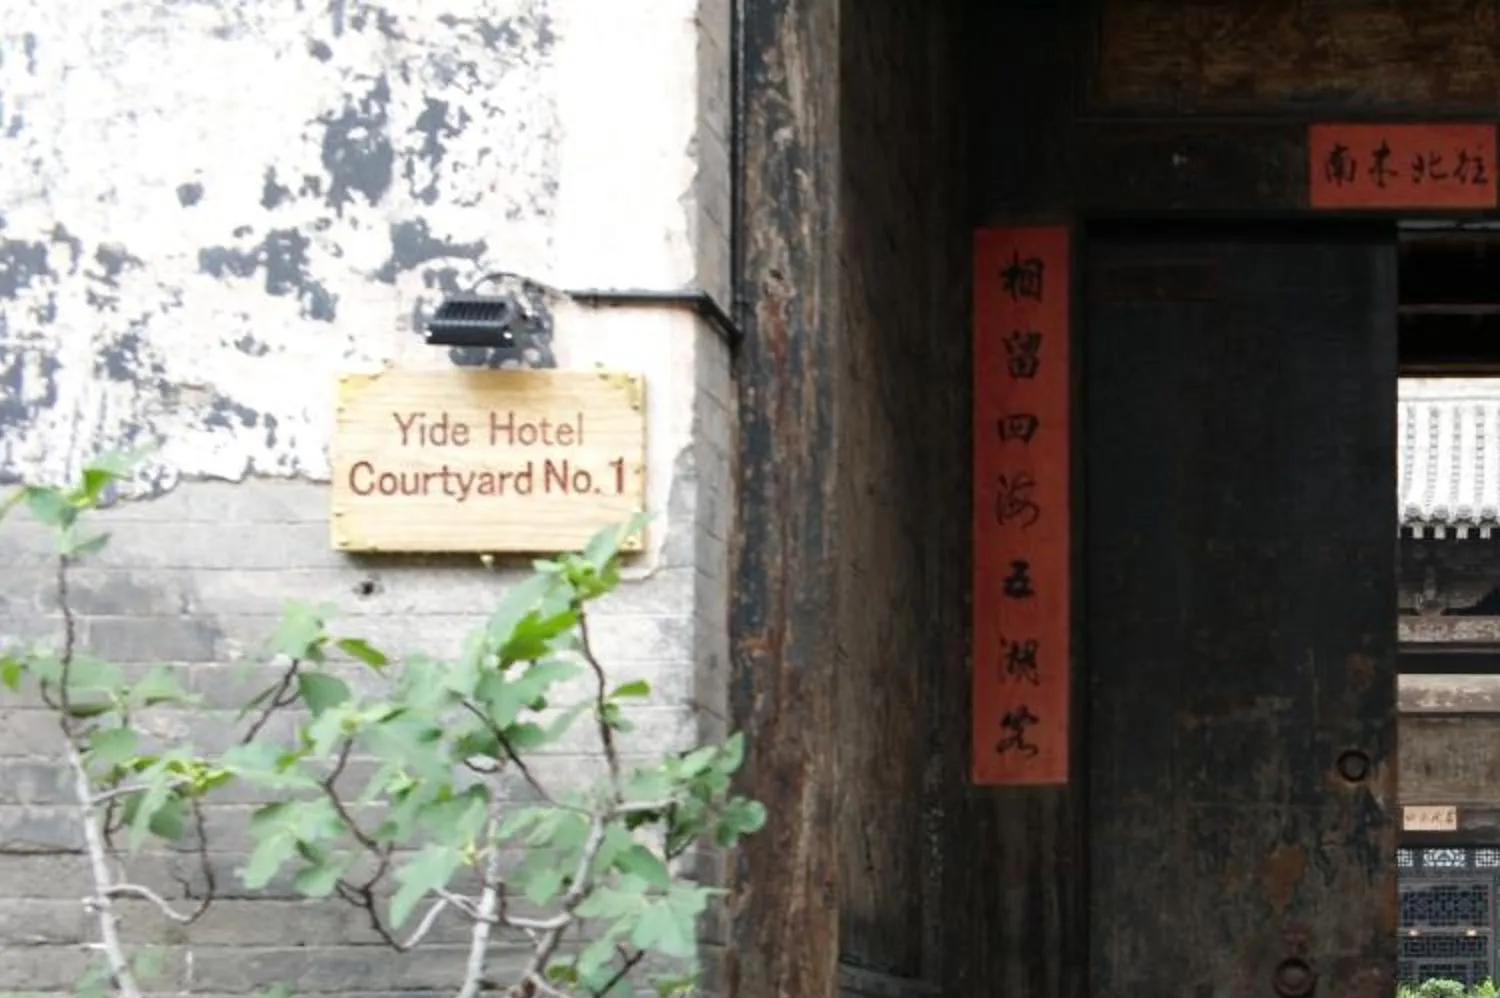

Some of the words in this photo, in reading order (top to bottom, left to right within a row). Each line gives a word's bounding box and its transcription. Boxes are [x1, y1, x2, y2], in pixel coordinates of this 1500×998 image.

[393, 411, 470, 447] Yide
[489, 410, 584, 447] Hotel
[350, 460, 533, 502] Courtyard
